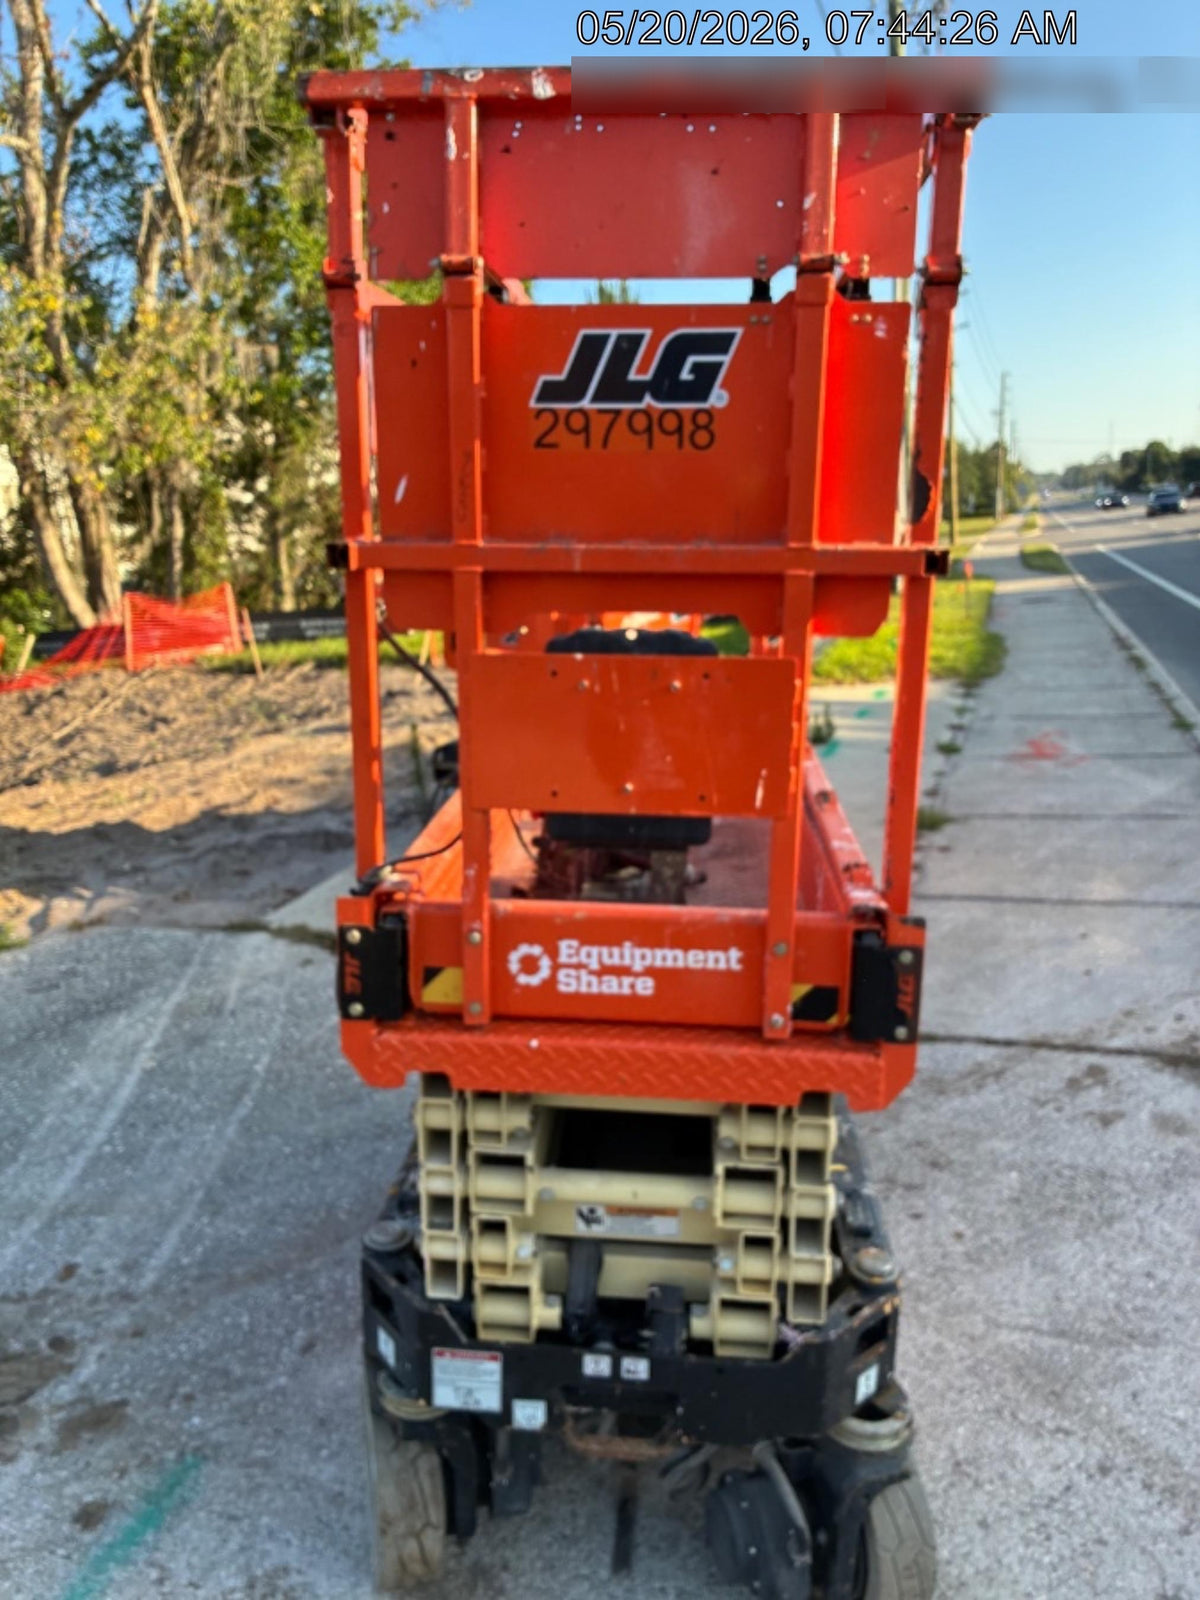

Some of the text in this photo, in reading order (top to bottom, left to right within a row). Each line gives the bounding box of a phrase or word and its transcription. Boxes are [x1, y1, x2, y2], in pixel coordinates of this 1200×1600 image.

[529, 327, 744, 408] JLG
[533, 408, 716, 451] 297998
[557, 939, 744, 973] Equipment
[557, 968, 655, 997] Share
